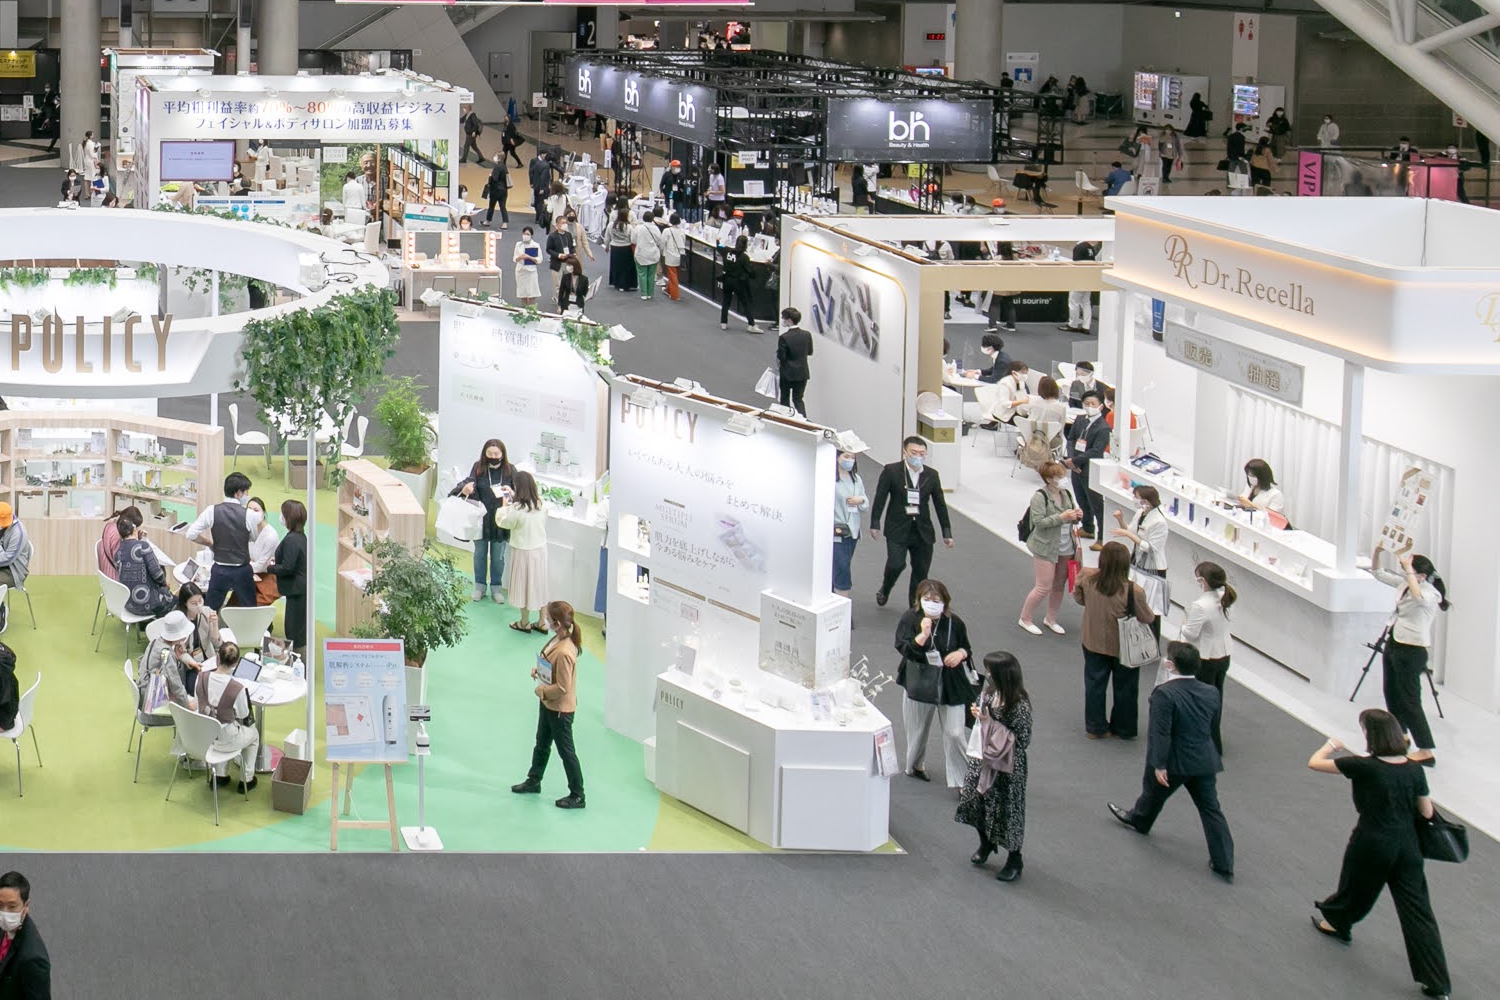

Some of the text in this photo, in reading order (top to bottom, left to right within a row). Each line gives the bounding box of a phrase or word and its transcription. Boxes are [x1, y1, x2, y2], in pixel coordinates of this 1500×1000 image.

[587, 22, 596, 45] 2
[579, 68, 592, 93] bh
[625, 79, 639, 107] bh
[678, 92, 696, 122] bh
[889, 111, 930, 140] bh
[1304, 162, 1316, 192] VIP
[11, 306, 173, 374] POLICY
[1184, 341, 1213, 367] 販売
[1249, 364, 1280, 391] 抽選
[660, 691, 684, 709] POLICY
